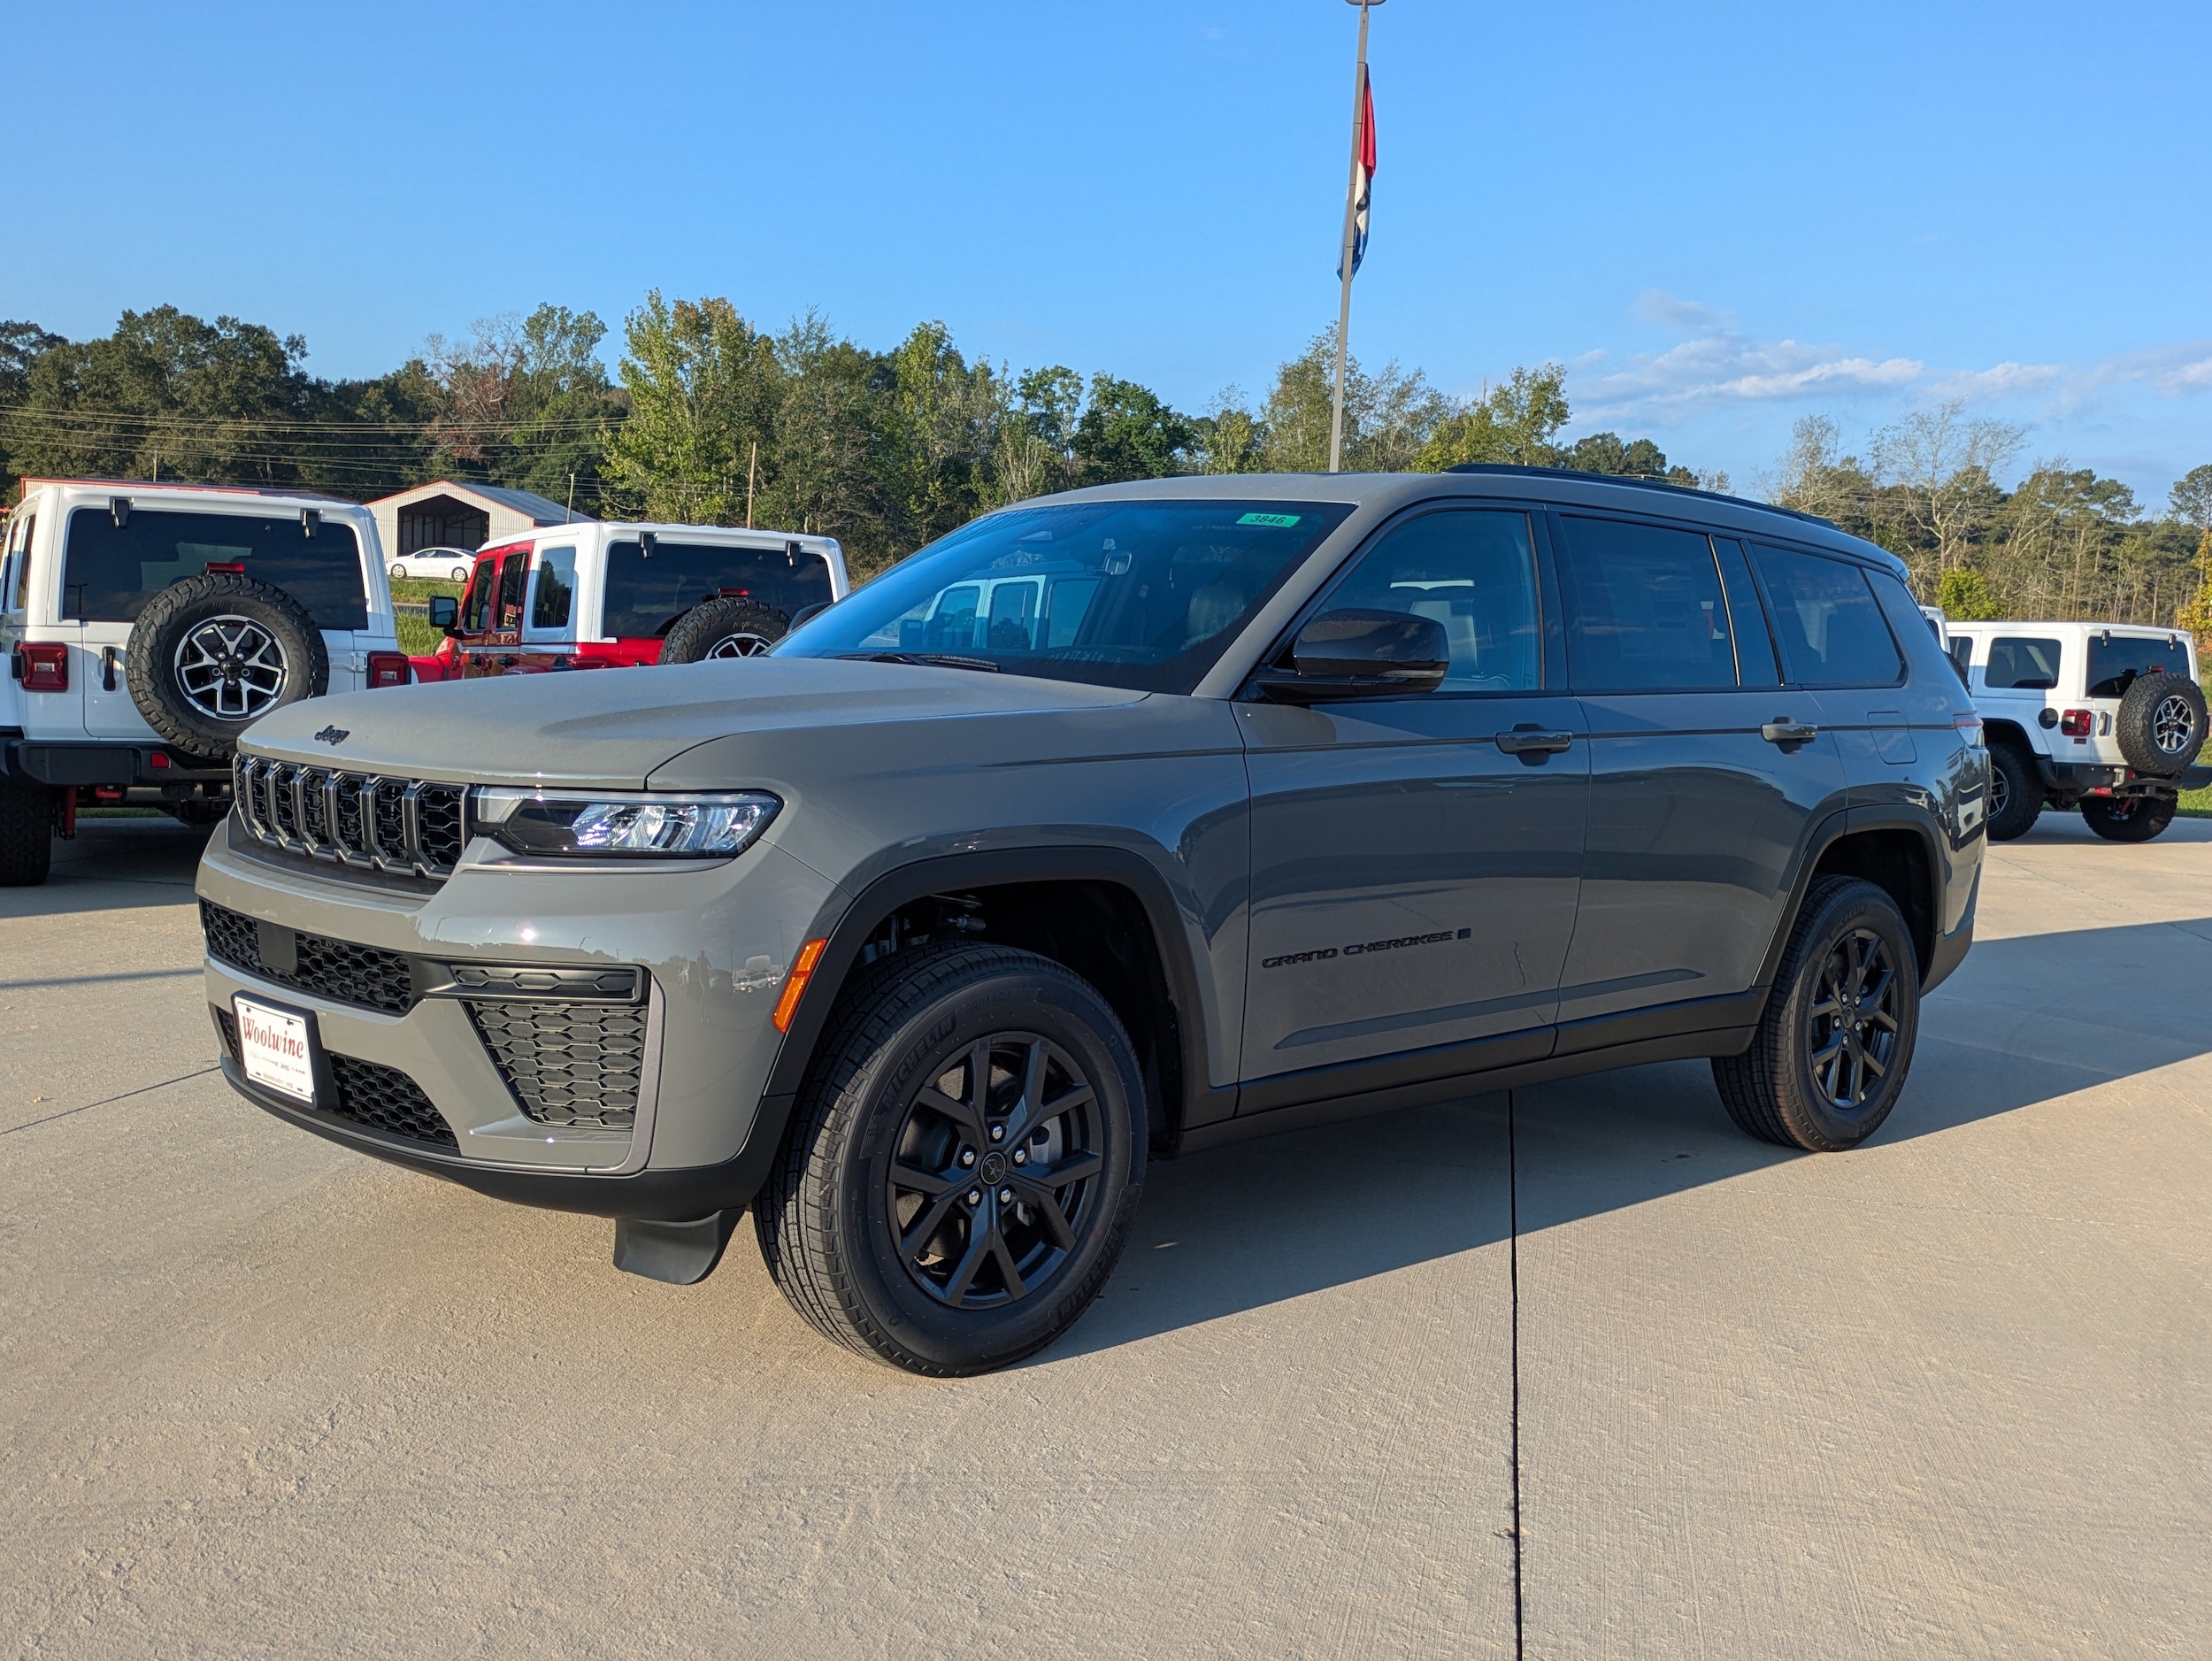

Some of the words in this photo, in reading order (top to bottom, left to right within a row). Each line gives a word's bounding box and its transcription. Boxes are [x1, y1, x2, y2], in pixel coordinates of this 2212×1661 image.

[1250, 515, 1286, 524] 3846
[314, 724, 350, 746] Jeep
[1262, 948, 1338, 968] GRAND
[1343, 930, 1454, 956] CHEROKEE
[242, 1016, 303, 1059] Woolwine
[882, 1015, 953, 1111] MICHELIN
